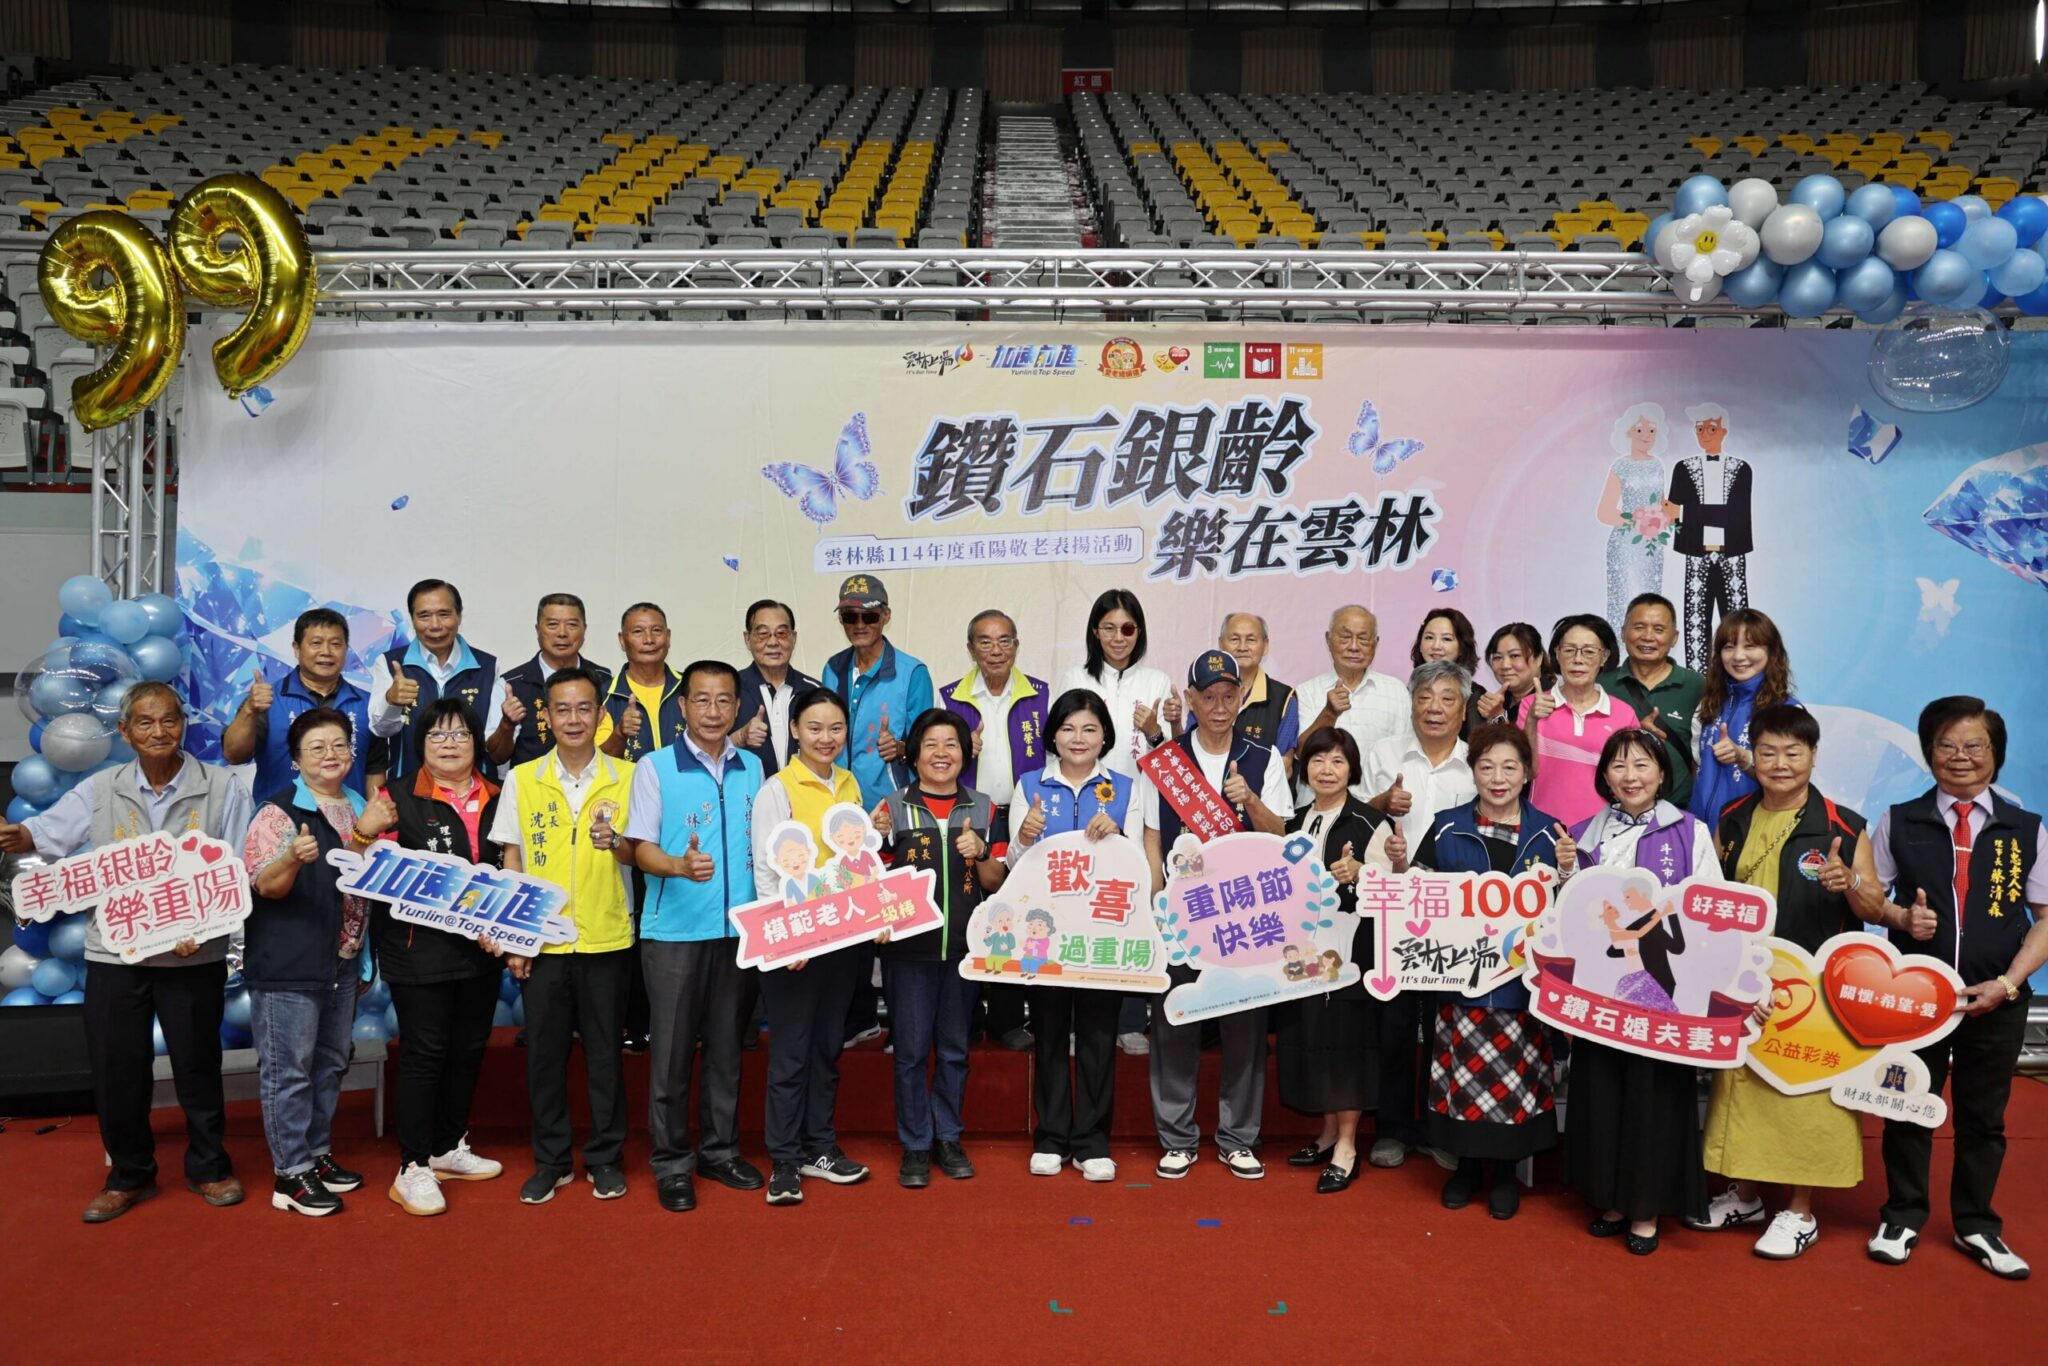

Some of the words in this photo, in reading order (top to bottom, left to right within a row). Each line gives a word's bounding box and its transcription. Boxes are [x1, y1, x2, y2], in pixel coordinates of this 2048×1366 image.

[988, 344, 1079, 369] 加速前進
[1207, 345, 1213, 354] 3
[1248, 345, 1254, 354] 4
[906, 399, 1315, 518] 鑽石銀齡
[825, 534, 1132, 566] 雲林縣114年度重陽敬老表揚活動
[1151, 495, 1434, 579] 樂在雲林
[20, 837, 173, 910] 幸福銀齡
[346, 848, 555, 936] 加速前進
[1182, 866, 1293, 923] 重陽節
[104, 865, 243, 942] 樂重陽
[397, 902, 485, 935] Yunlin@Top
[487, 926, 537, 947] Speed
[762, 895, 867, 945] 模範老人
[865, 899, 917, 924] 一級棒
[1691, 894, 1760, 926] 好幸福
[1058, 934, 1152, 967] 過重陽
[1212, 911, 1287, 957] 快樂
[1392, 936, 1501, 990] 雲林上場
[1401, 975, 1418, 984] It's
[1421, 976, 1439, 984] Our
[1442, 976, 1466, 985] Time
[1560, 994, 1715, 1053] 鑽石婚夫妻
[1763, 1037, 1841, 1069] 公益彩券
[1843, 1087, 1937, 1120] 財政部關心您
